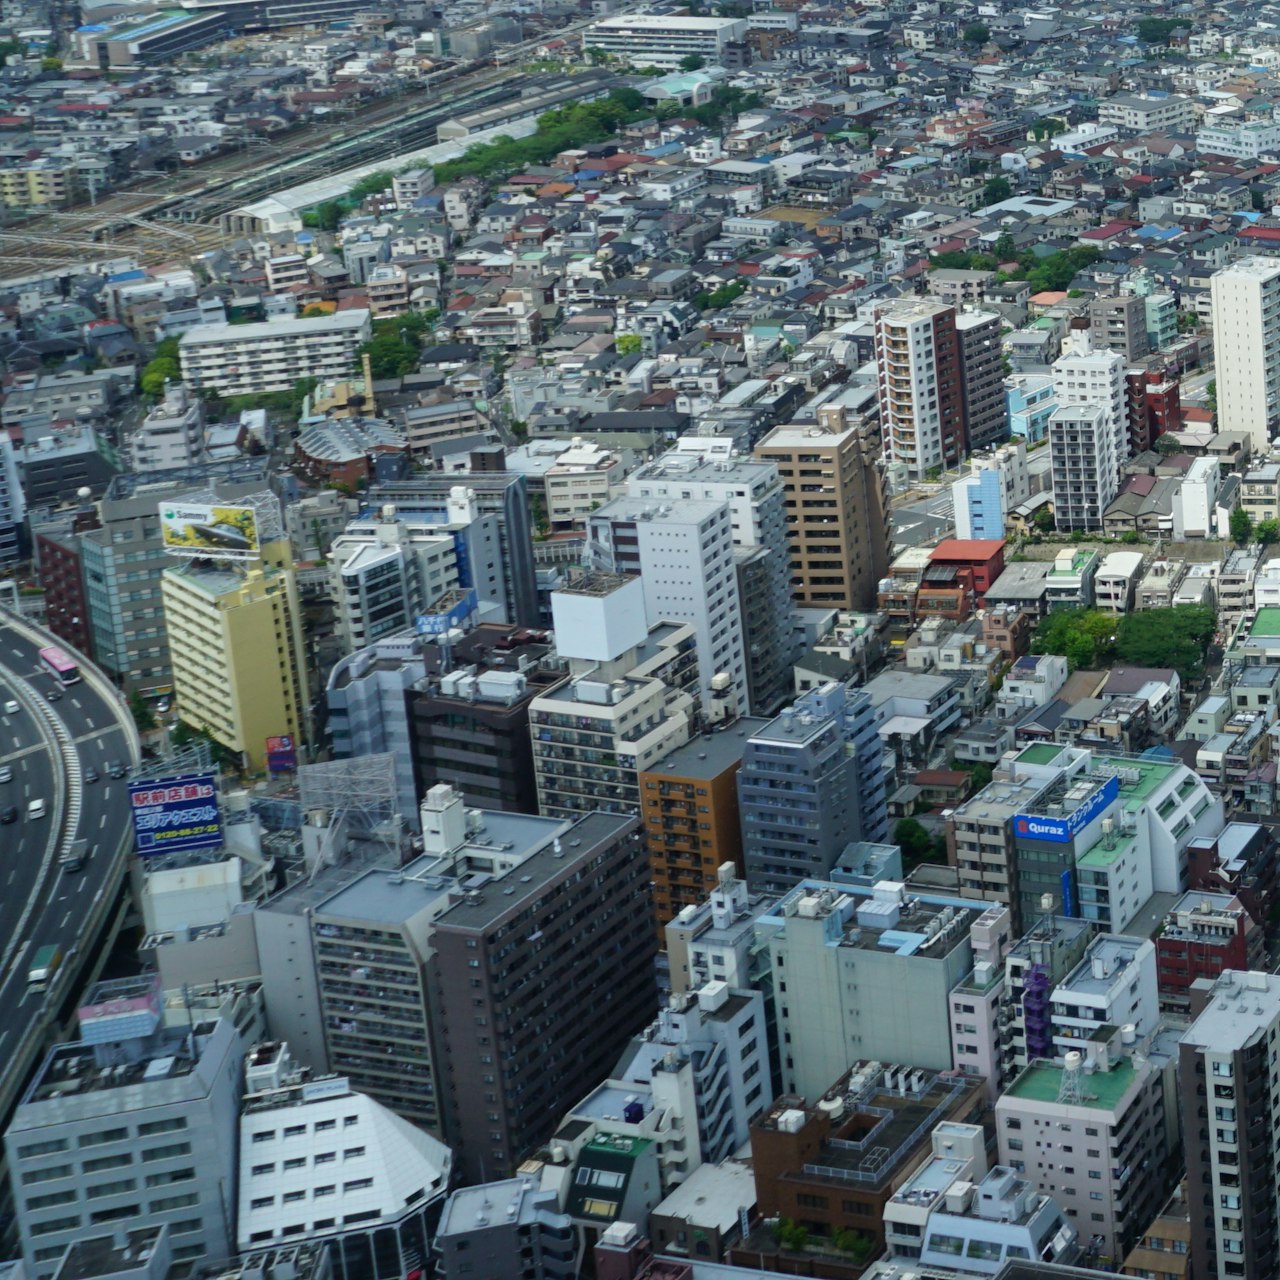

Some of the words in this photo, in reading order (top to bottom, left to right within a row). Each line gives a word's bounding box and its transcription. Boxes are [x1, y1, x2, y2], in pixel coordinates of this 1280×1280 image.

[176, 510, 208, 521] Sammy
[136, 805, 218, 830] エリアクエスト
[1028, 822, 1064, 835] Quraz
